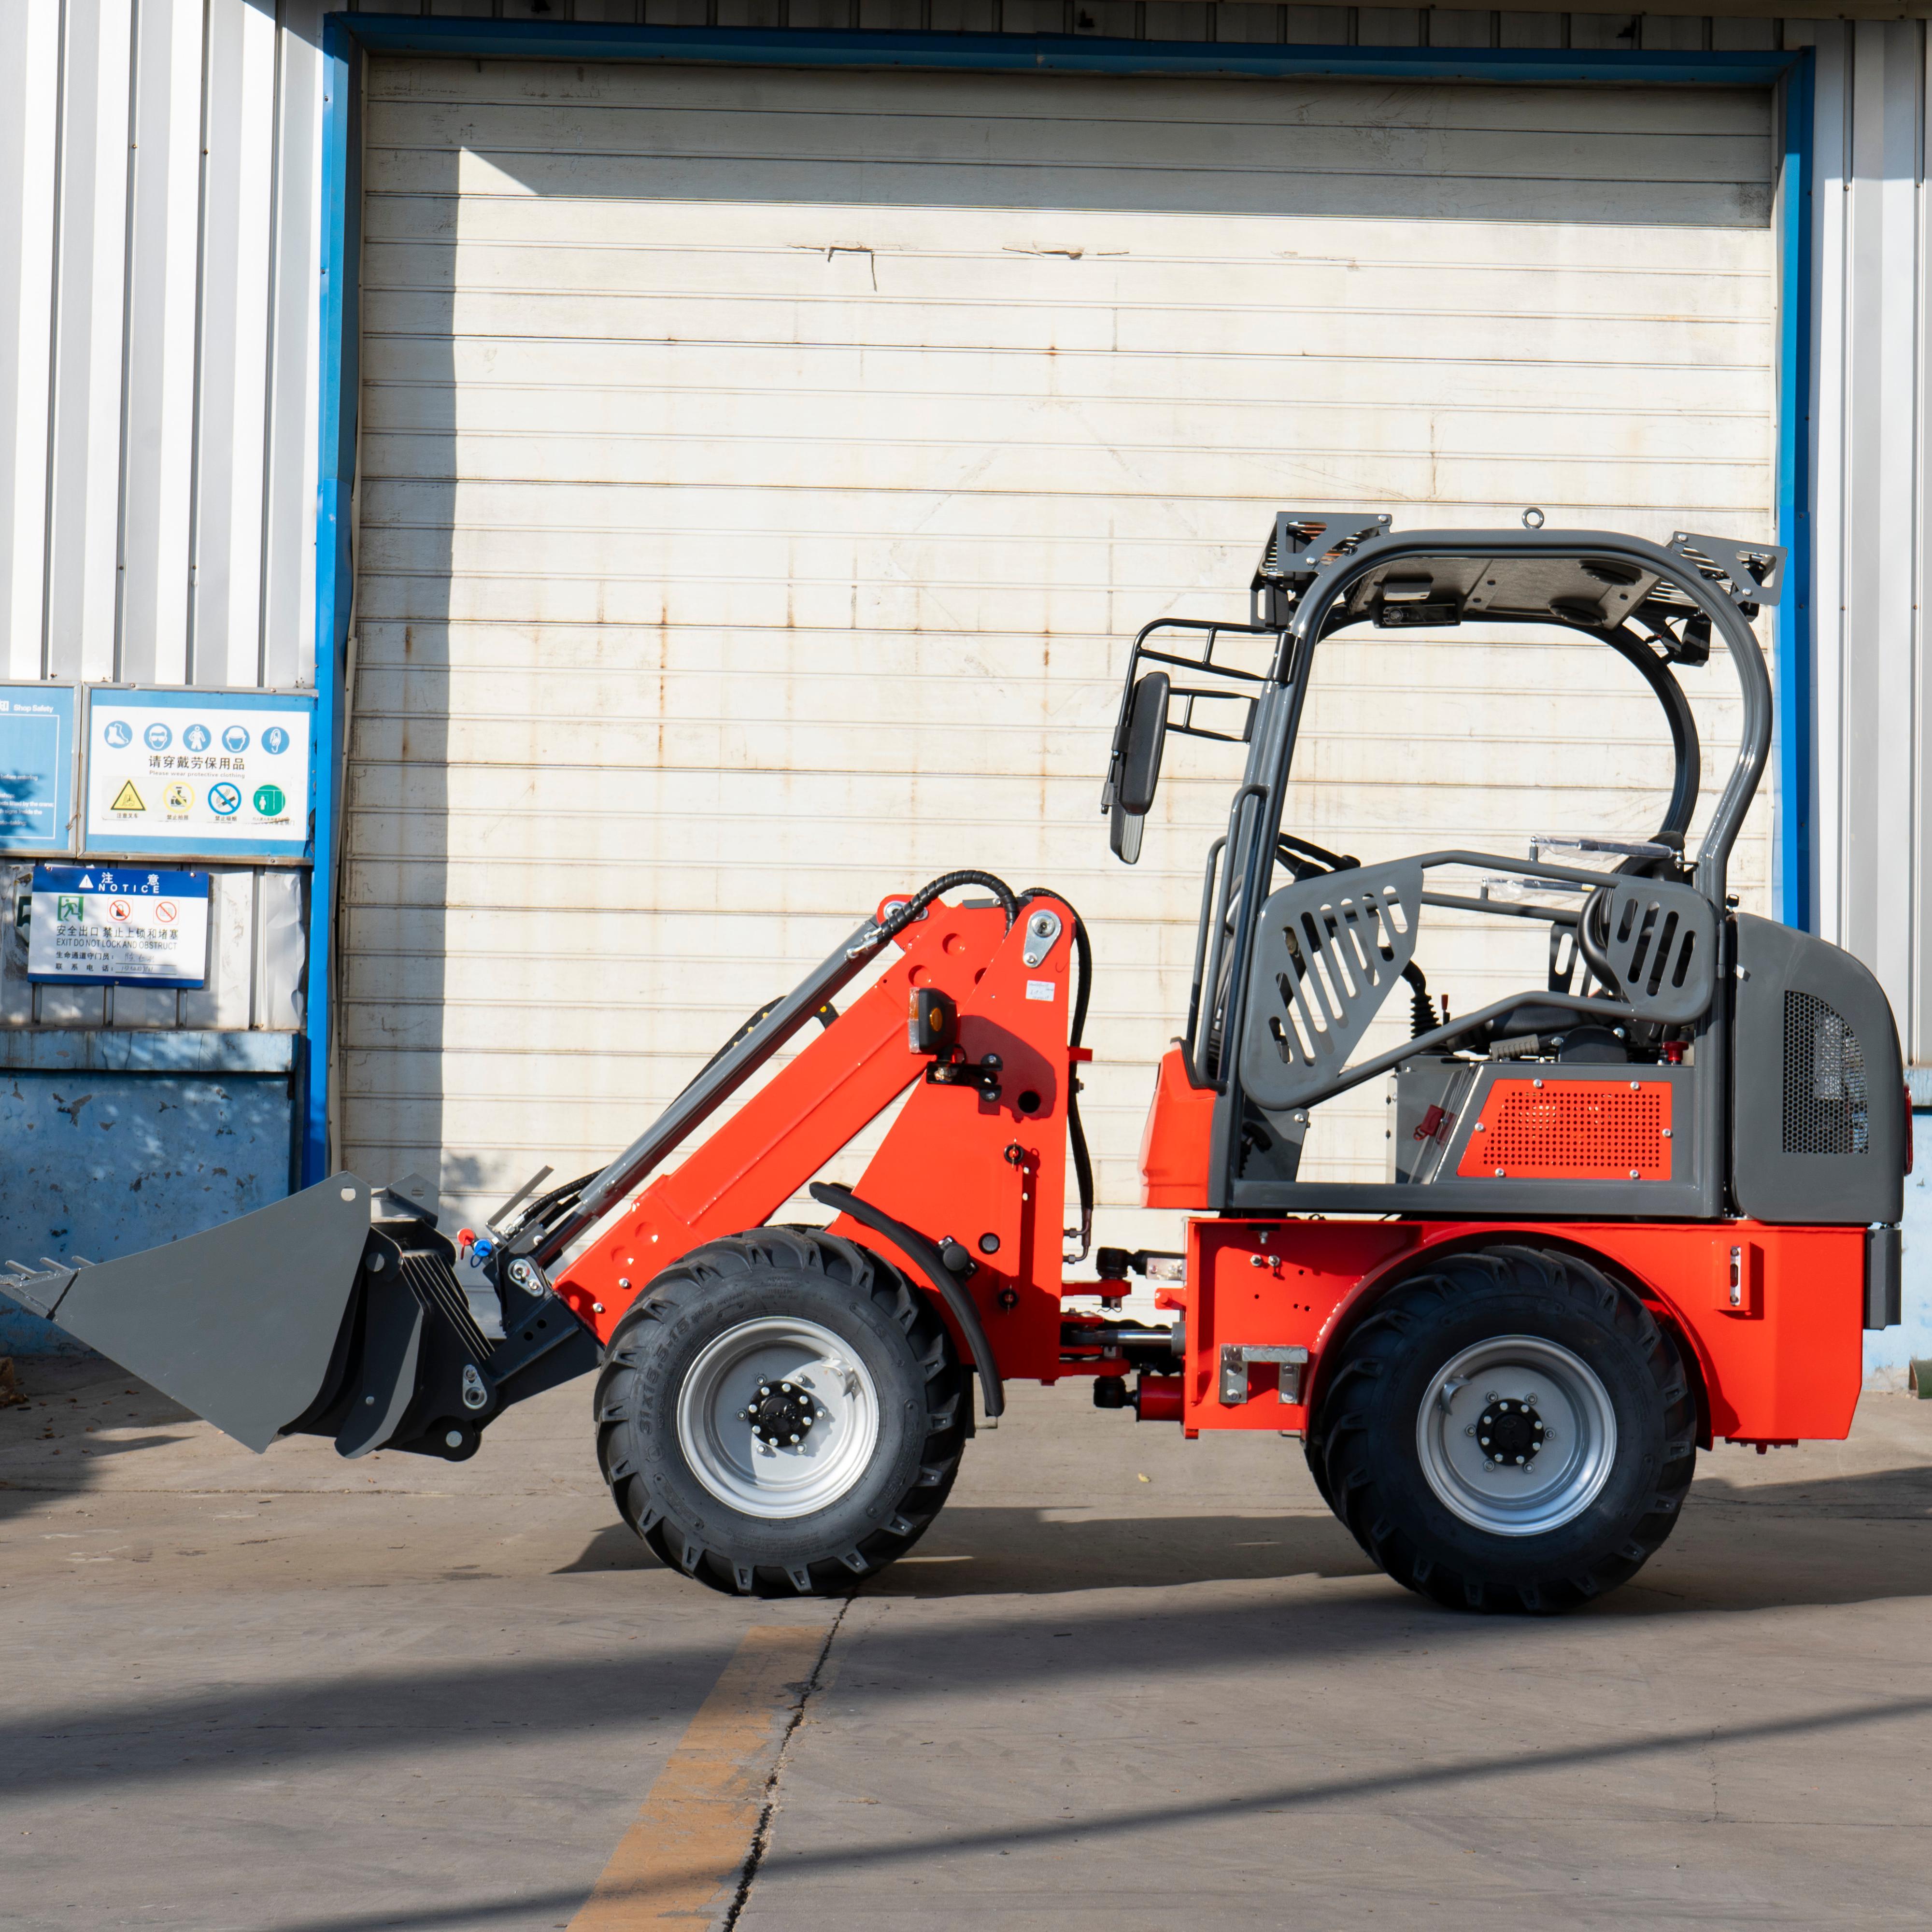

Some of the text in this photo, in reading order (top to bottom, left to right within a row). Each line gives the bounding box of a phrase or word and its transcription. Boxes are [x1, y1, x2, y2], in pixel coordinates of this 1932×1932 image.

[14, 704, 54, 713] Shop Safety
[149, 755, 245, 770] 请穿戴劳保用品
[98, 883, 159, 894] NOTICE
[56, 938, 177, 950] EXIT DO NOT LOCK AND OBSTRUCT
